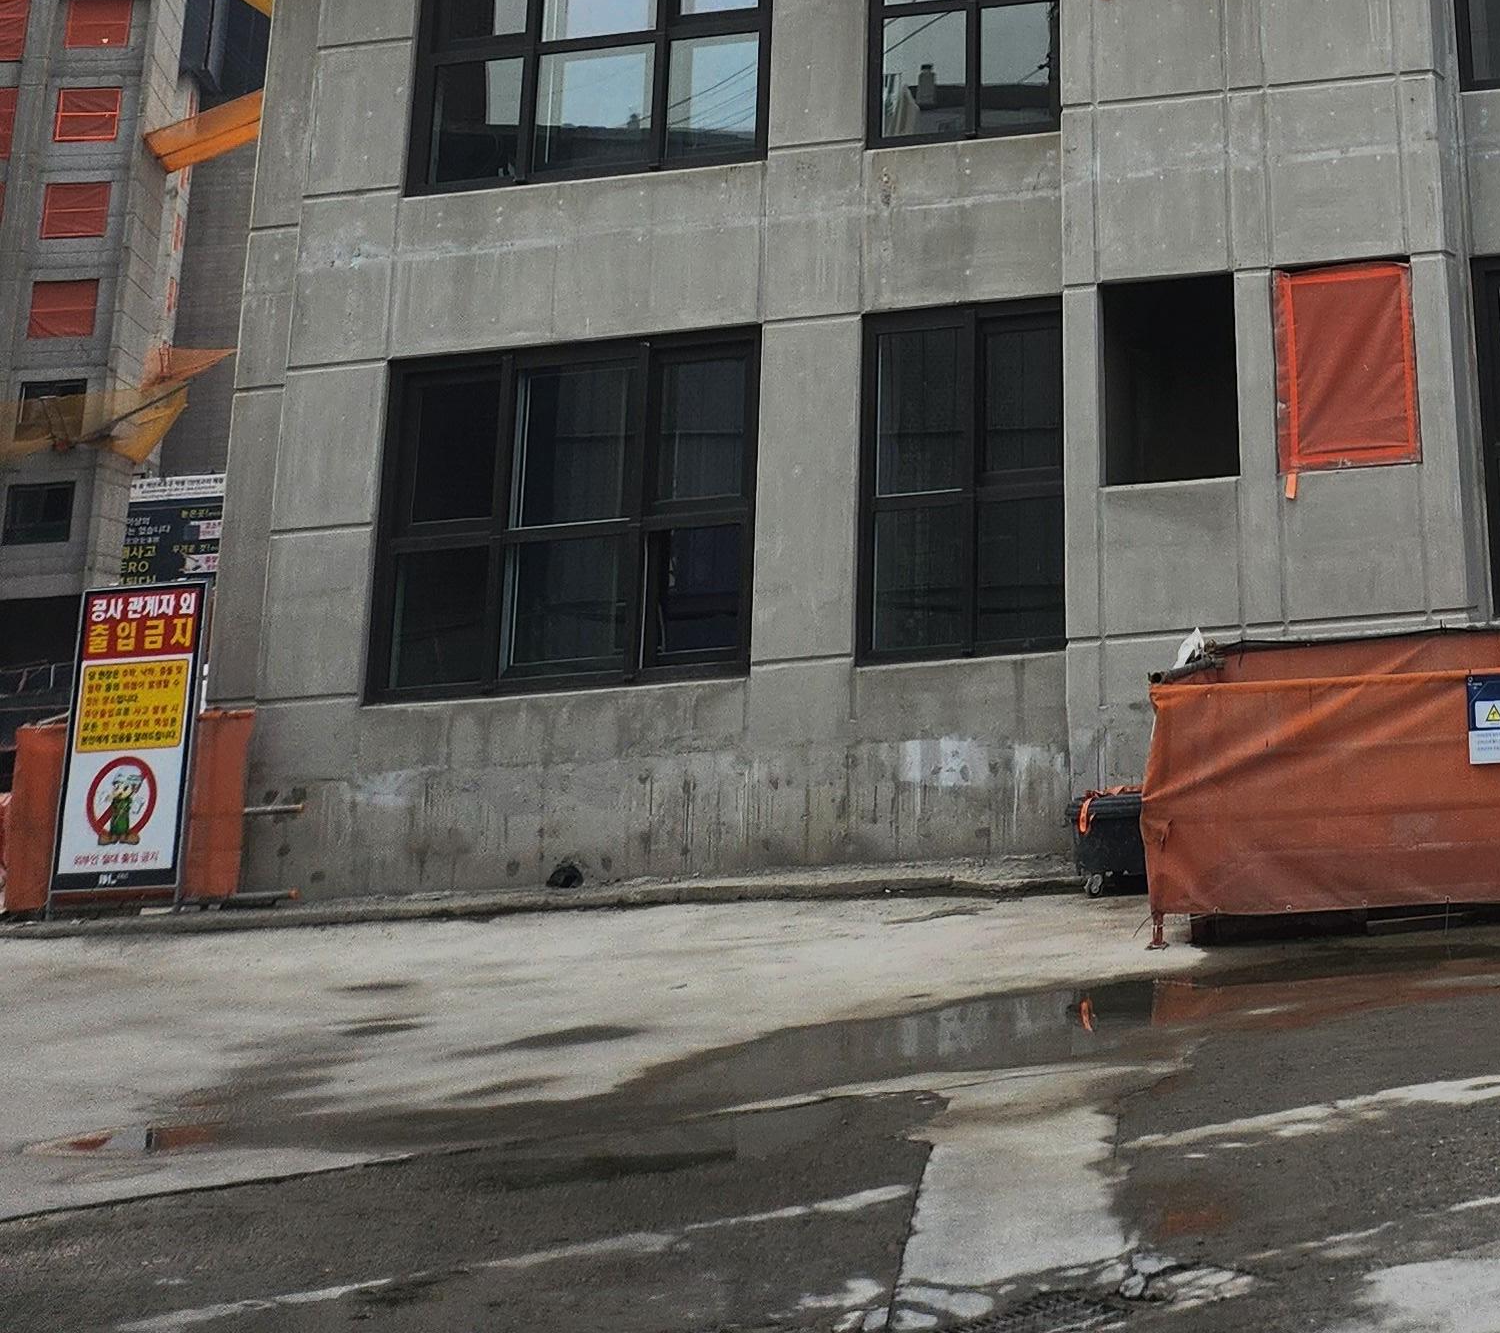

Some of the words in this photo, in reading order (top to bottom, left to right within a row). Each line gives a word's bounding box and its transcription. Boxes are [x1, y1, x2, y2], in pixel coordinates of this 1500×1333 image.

[120, 561, 149, 573] ERO
[92, 598, 123, 622] 공사
[127, 594, 175, 619] 관계자
[179, 593, 196, 614] 외
[88, 617, 193, 653] 출입금지
